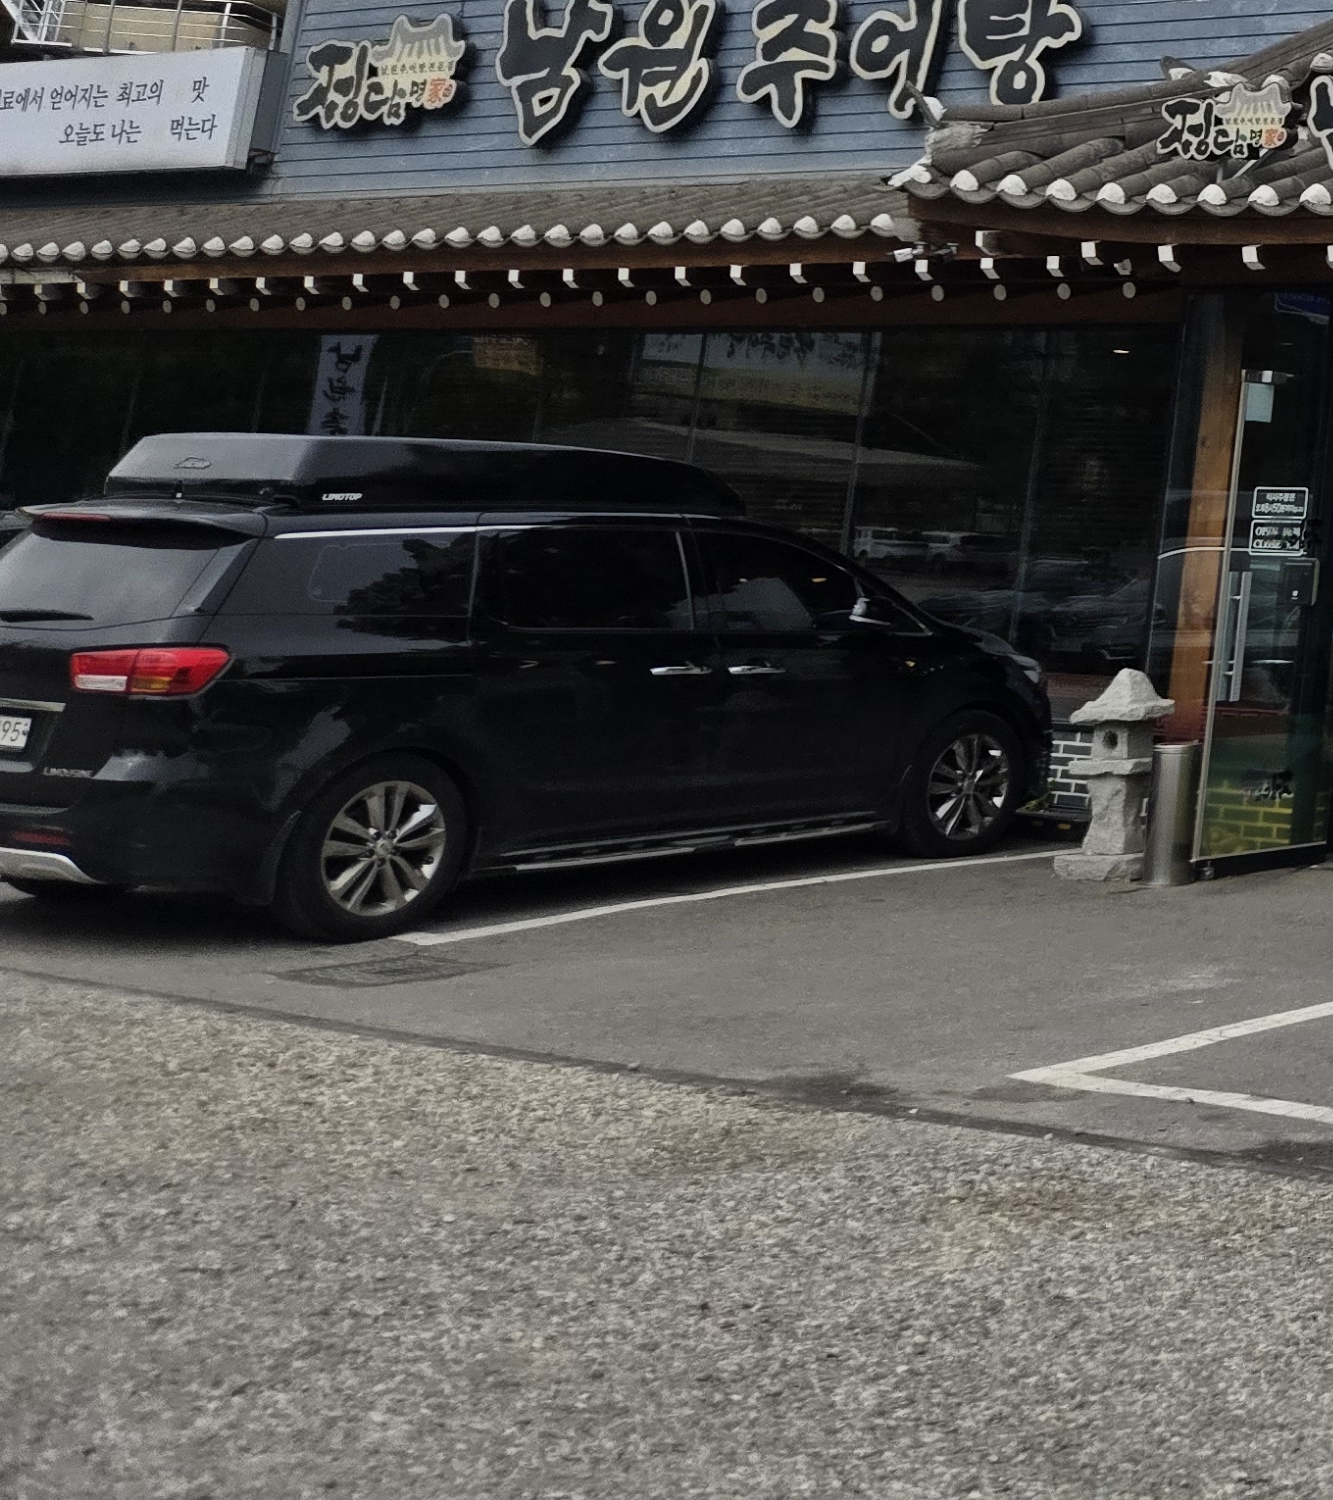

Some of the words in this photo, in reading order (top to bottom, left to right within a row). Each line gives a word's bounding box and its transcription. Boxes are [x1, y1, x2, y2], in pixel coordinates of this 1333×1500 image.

[0, 85, 45, 112] 료에서
[50, 83, 109, 111] 얻어지는
[117, 79, 164, 107] 최고의
[191, 76, 209, 103] 맛
[58, 122, 106, 146] 오늘도
[111, 120, 142, 144] 나는
[170, 114, 218, 141] 먹는다
